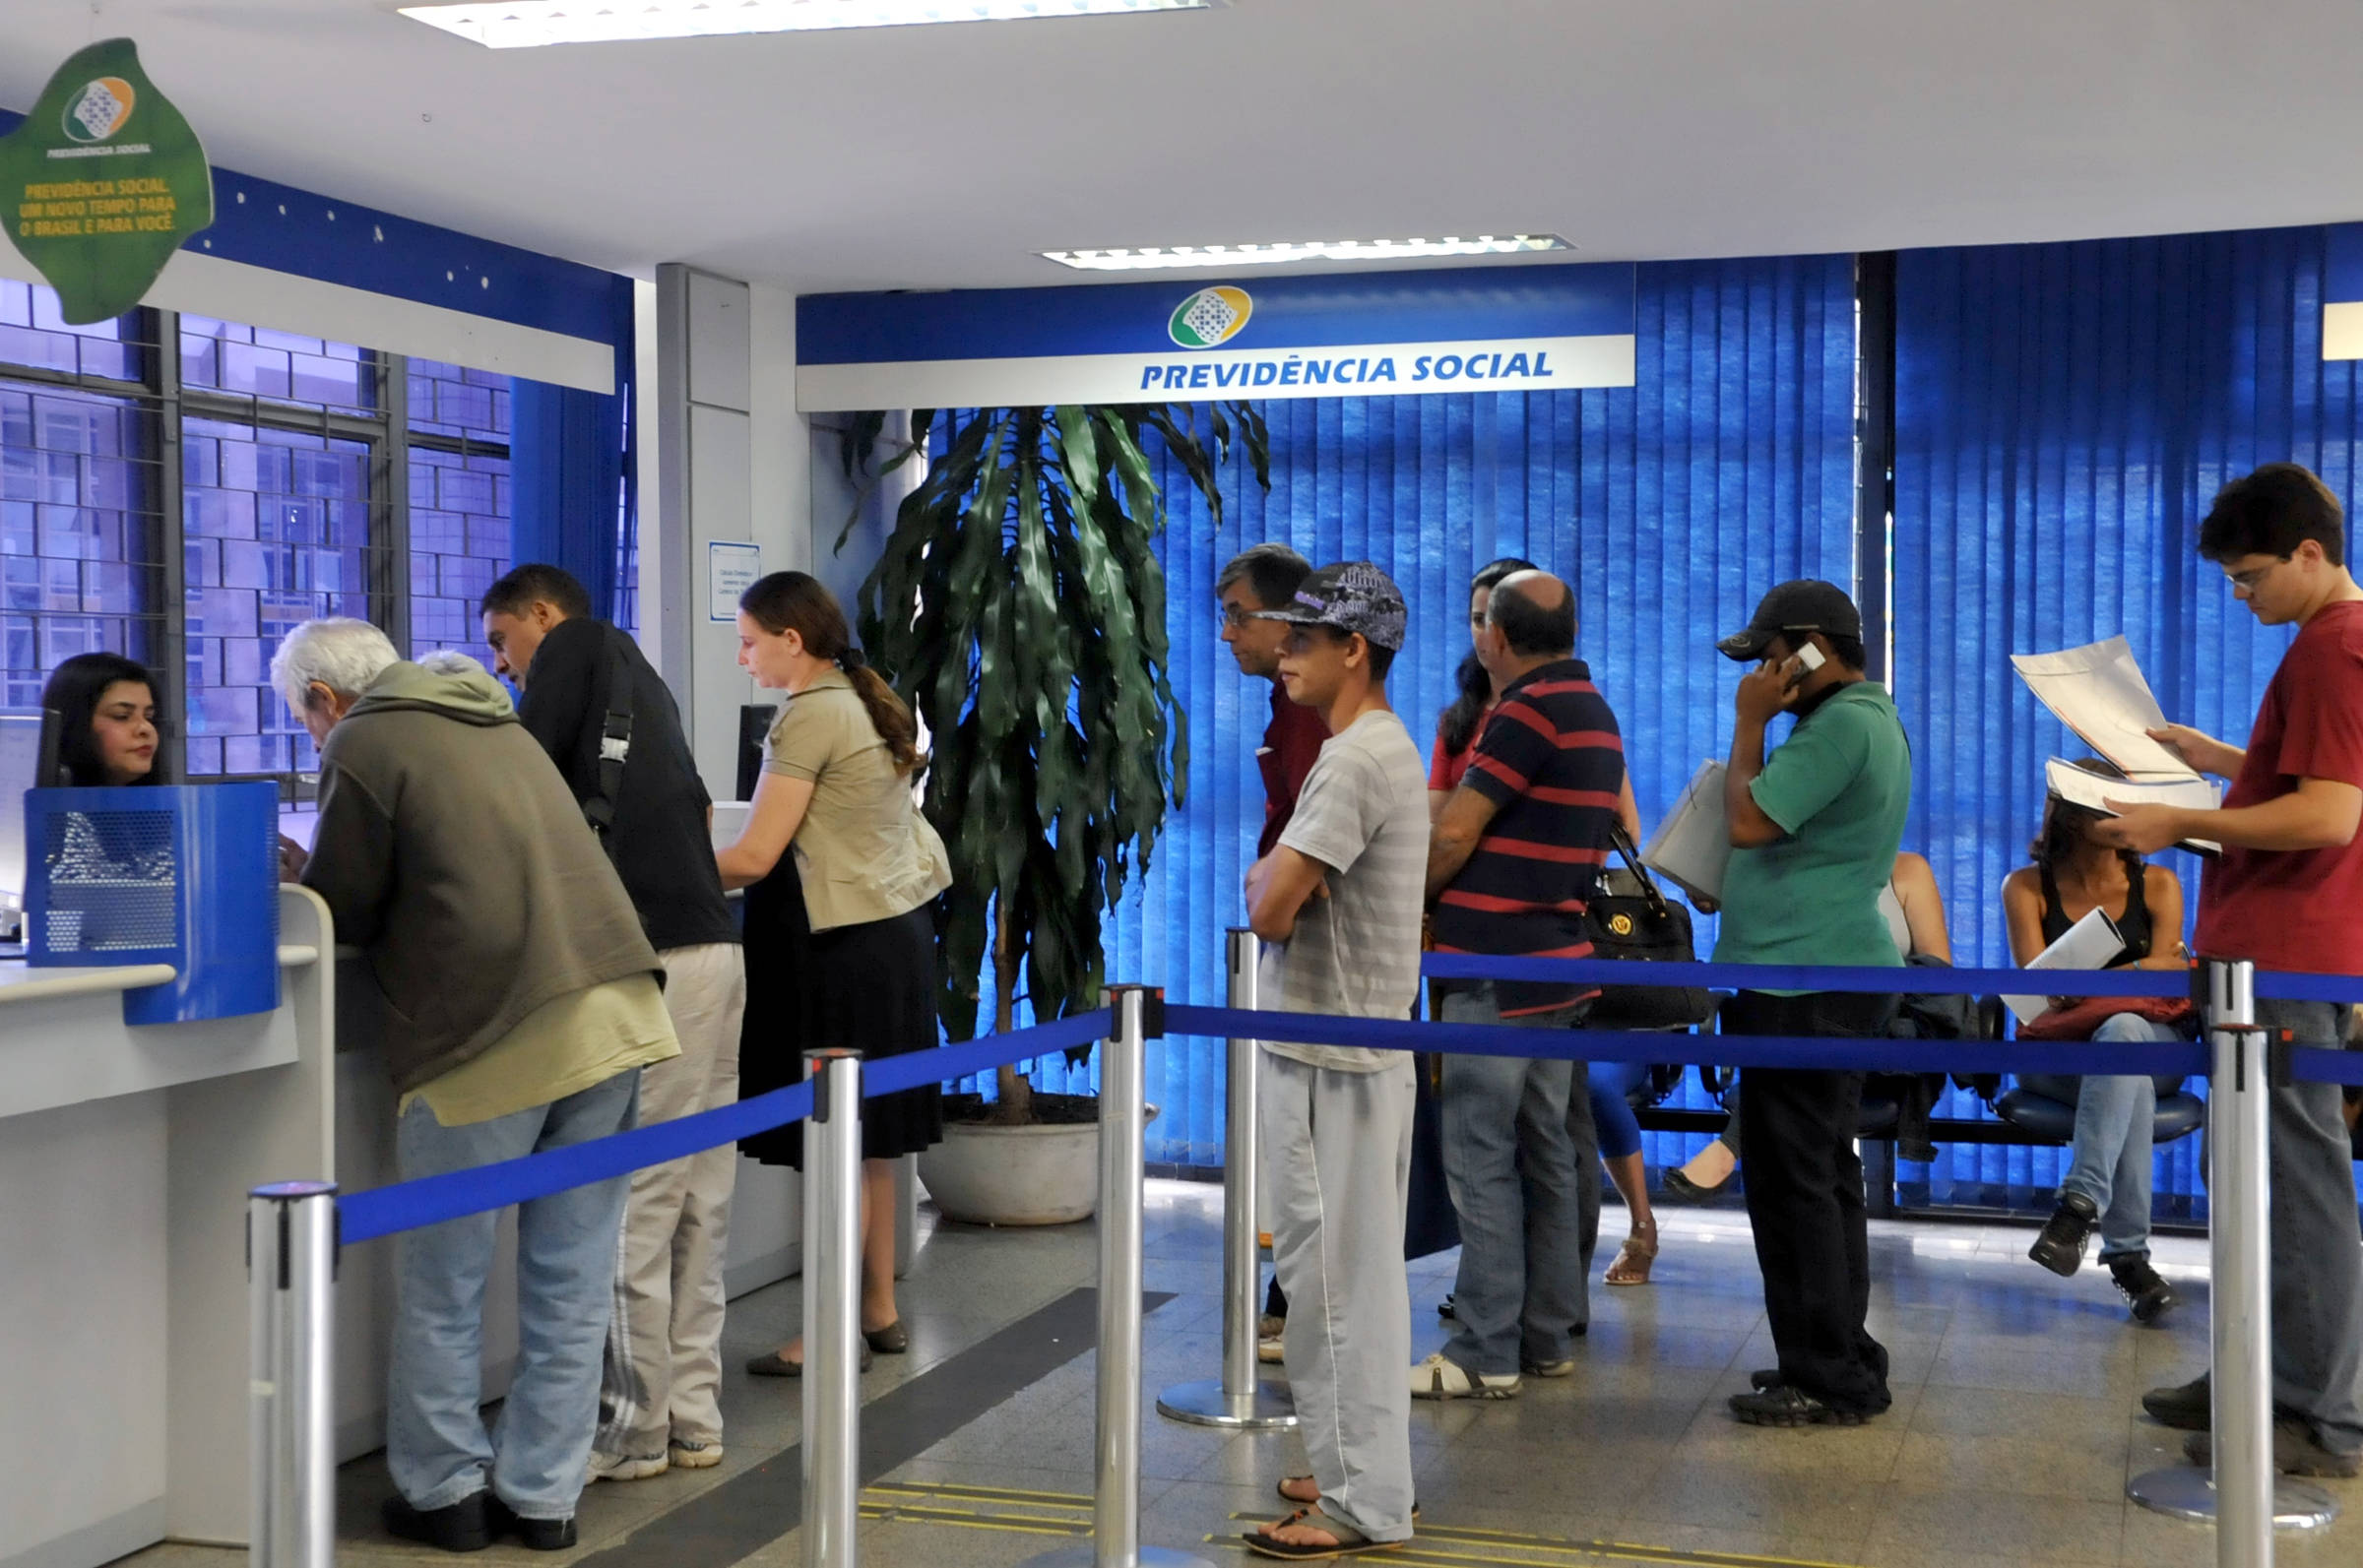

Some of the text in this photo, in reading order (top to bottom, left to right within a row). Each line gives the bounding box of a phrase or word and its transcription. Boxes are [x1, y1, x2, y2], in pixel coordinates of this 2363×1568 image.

[25, 179, 114, 199] PREVIDÊNCIA
[19, 197, 176, 219] UM NOVO TEMPO PARA
[20, 221, 31, 236] O
[33, 220, 81, 236] BRASIL
[85, 219, 94, 234] E
[96, 218, 133, 232] PARA
[1140, 351, 1554, 390] PREVIDÊNCIA SOCIAL
